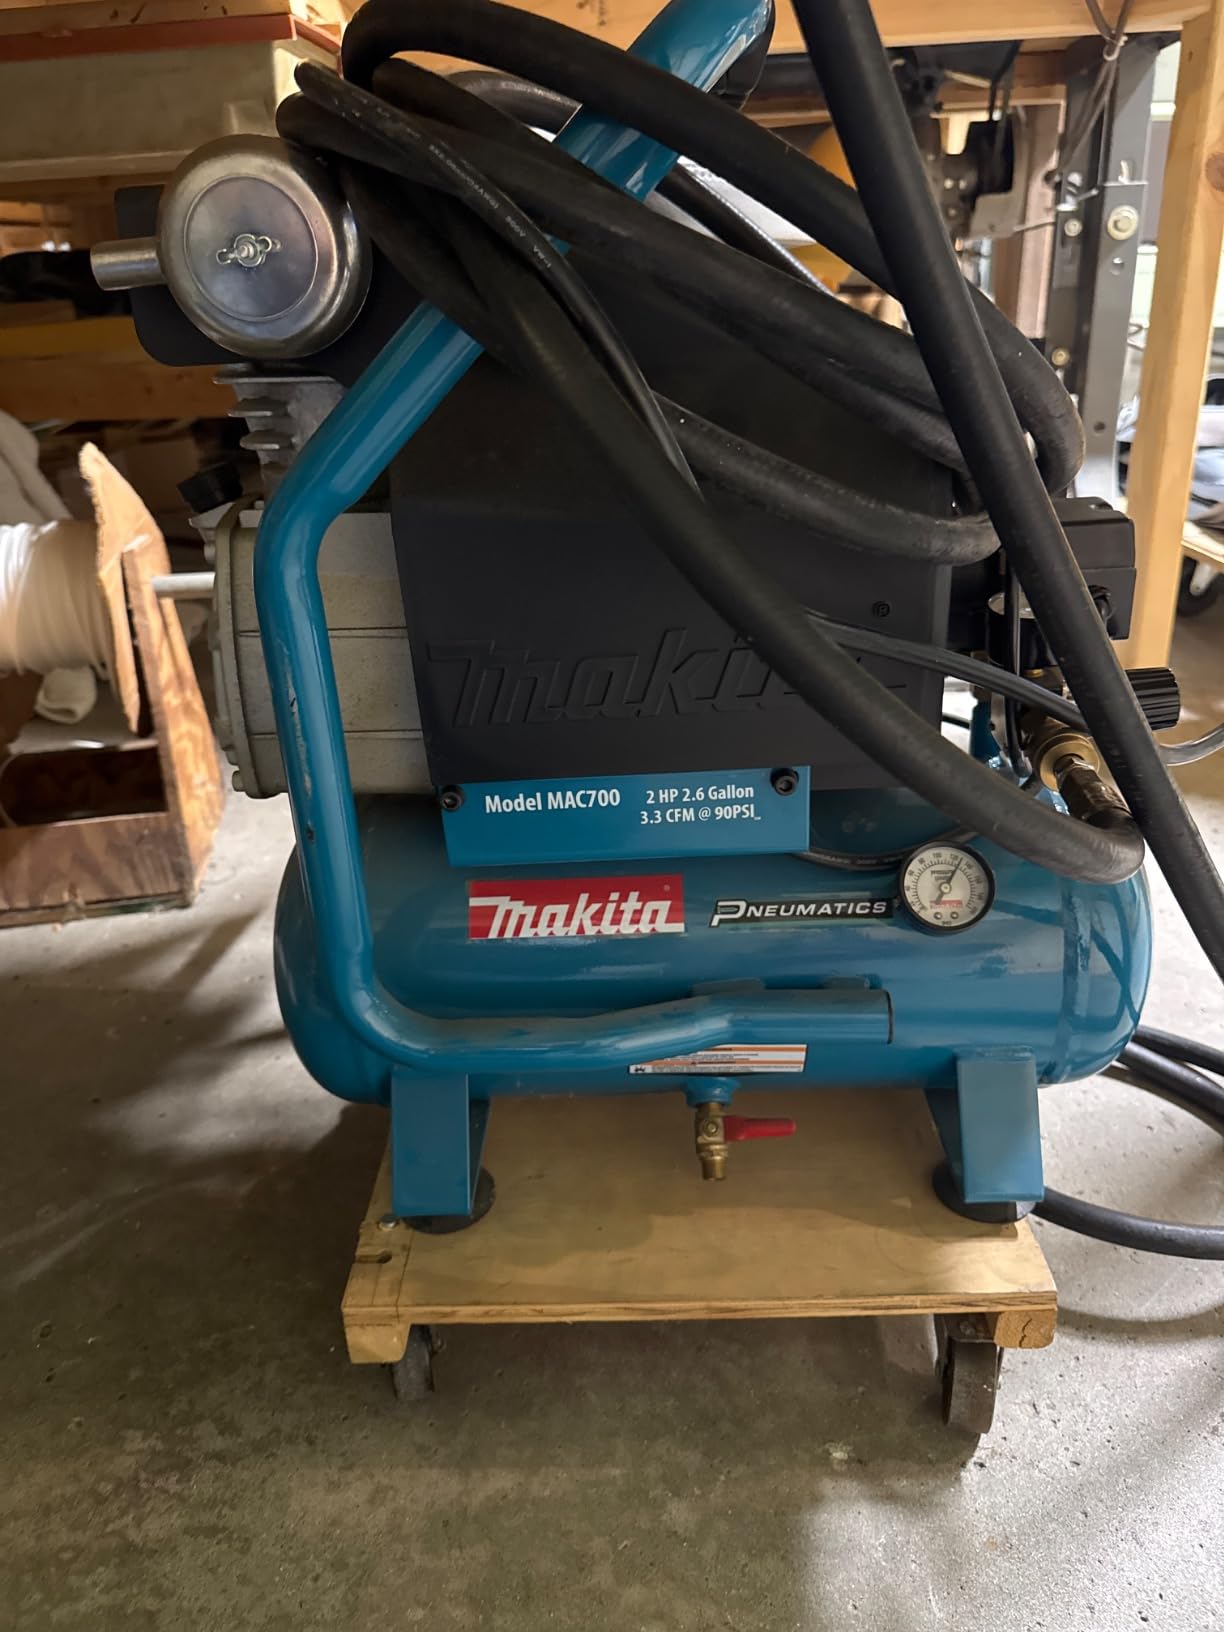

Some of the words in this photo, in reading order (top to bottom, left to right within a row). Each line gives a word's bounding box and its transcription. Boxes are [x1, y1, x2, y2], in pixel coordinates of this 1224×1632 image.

[485, 792, 542, 813] Model
[547, 788, 620, 810] MAC700
[646, 790, 655, 804] 2
[659, 788, 678, 803] HP
[682, 787, 704, 802] 2.6
[708, 784, 754, 800] Gallon
[640, 810, 662, 825] 3.3
[666, 807, 695, 822] CFM
[698, 807, 711, 821] @
[711, 900, 887, 927] PNEUMATICS
